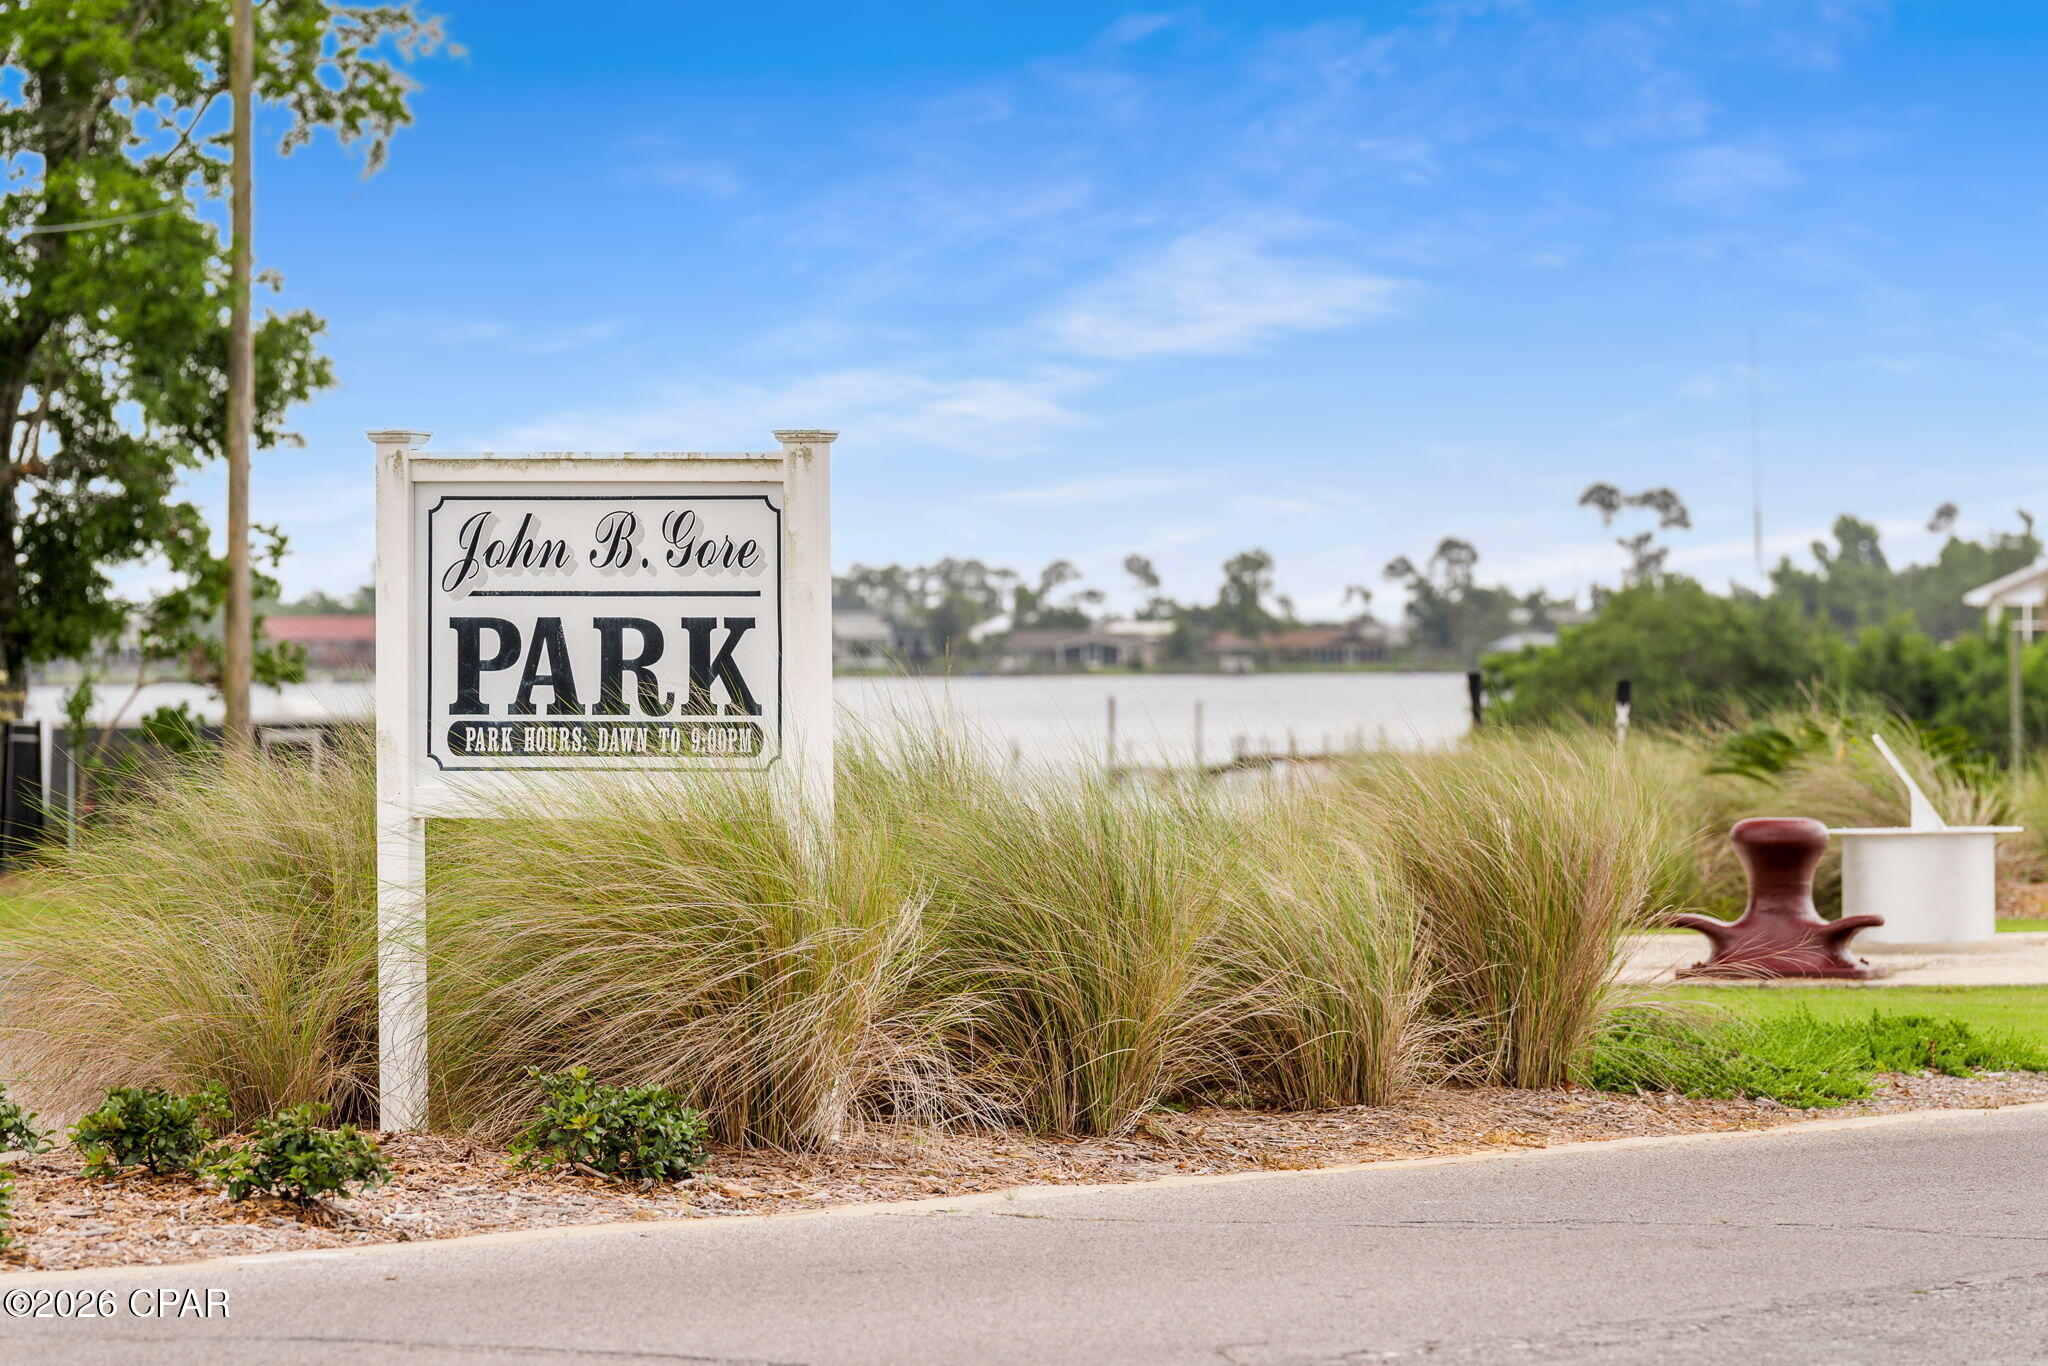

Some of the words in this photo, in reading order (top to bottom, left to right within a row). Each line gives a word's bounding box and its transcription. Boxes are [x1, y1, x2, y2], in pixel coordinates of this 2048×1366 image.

[442, 511, 570, 592] John
[589, 510, 649, 569] B.
[662, 510, 760, 569] Gore
[449, 617, 762, 717] PARK
[465, 727, 513, 752] PARK
[524, 727, 588, 752] HOURS:
[598, 727, 649, 752] DAWN
[659, 728, 682, 752] TO
[691, 728, 752, 752] 9:00PM
